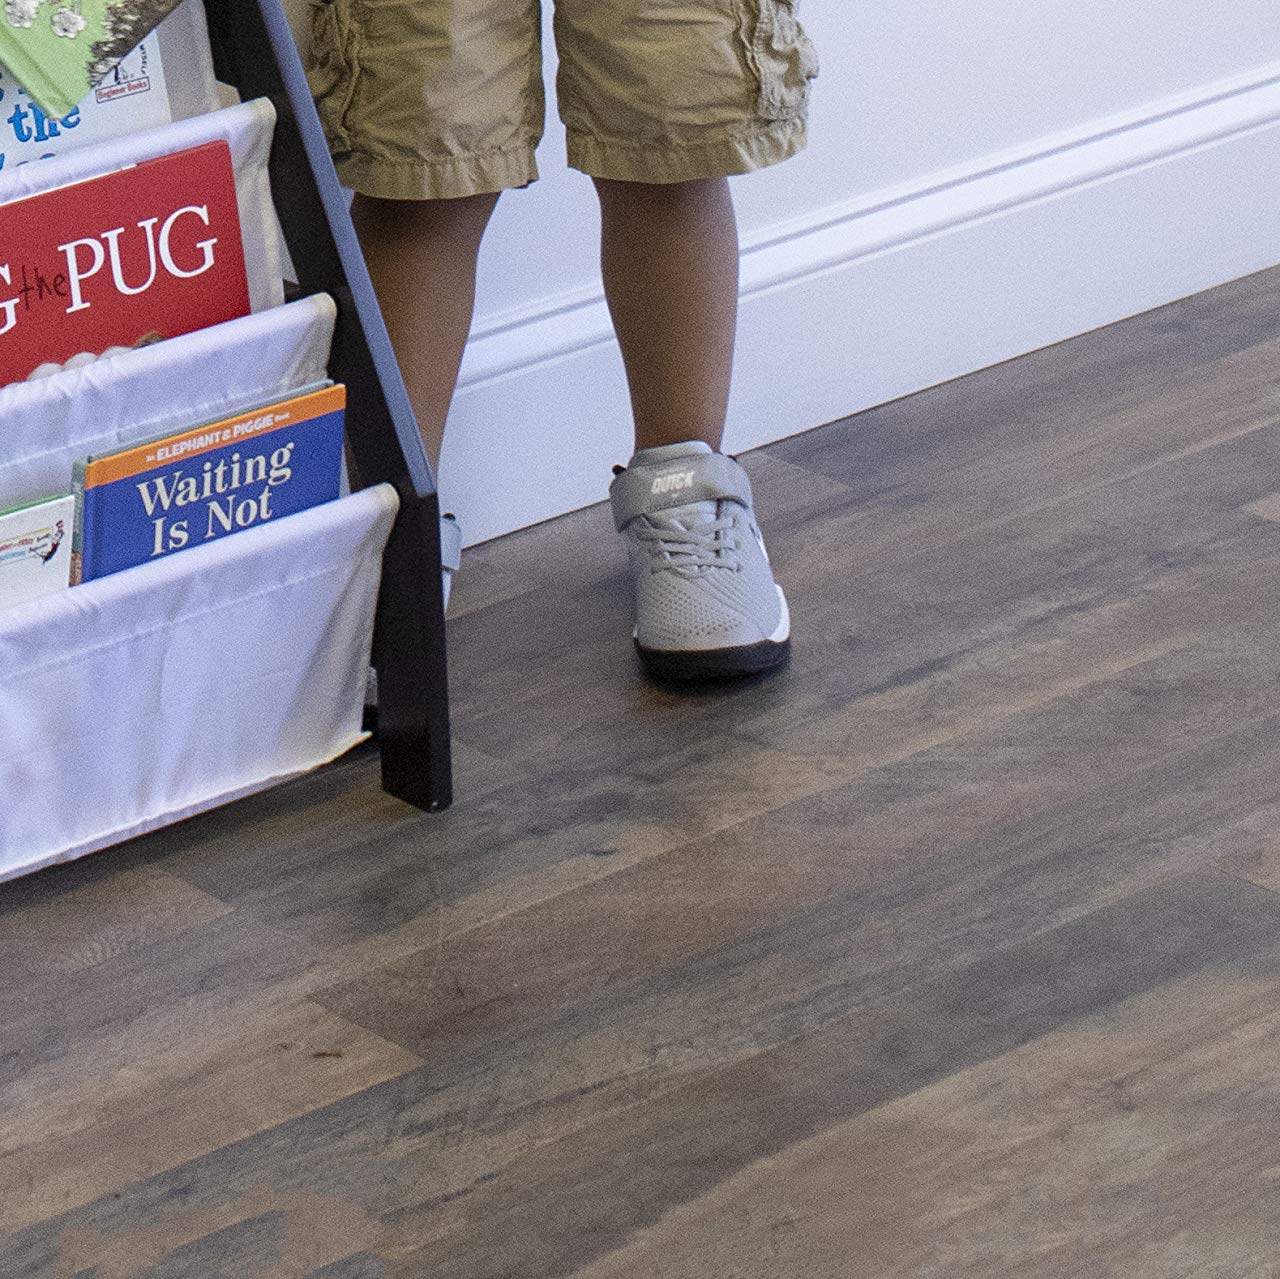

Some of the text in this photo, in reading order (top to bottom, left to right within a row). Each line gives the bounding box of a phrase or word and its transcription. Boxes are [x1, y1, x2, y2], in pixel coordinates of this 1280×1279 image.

[19, 265, 68, 311] the
[57, 204, 218, 314] PUG
[157, 431, 221, 461] ELEPHANT
[222, 429, 231, 440] &
[233, 414, 275, 438] PIGGIE
[137, 442, 295, 517] Waiting
[150, 485, 272, 557] Is Not
